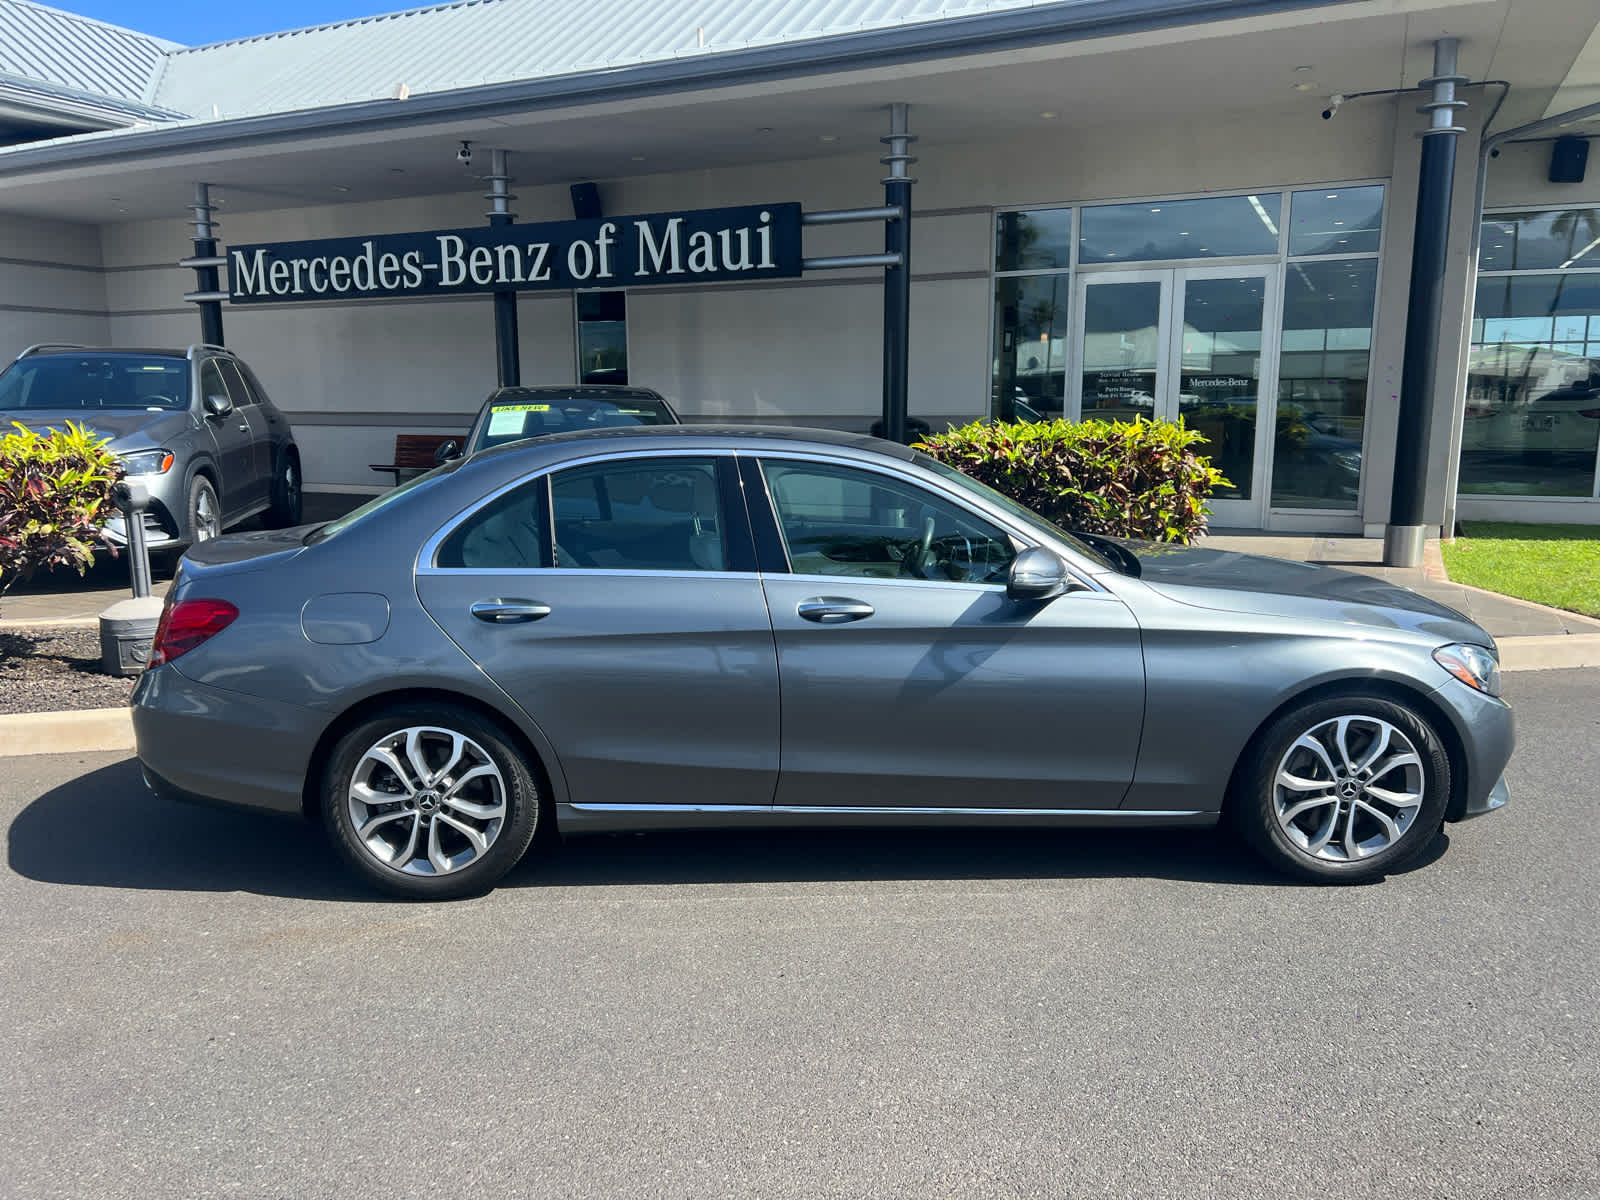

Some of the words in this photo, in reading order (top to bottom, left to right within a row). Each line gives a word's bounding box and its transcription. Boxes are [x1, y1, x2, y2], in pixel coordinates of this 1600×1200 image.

[232, 235, 551, 296] Mercedes-Benz
[567, 222, 616, 280] of
[633, 211, 776, 276] Maui
[1190, 377, 1248, 387] Mercedes-Benz
